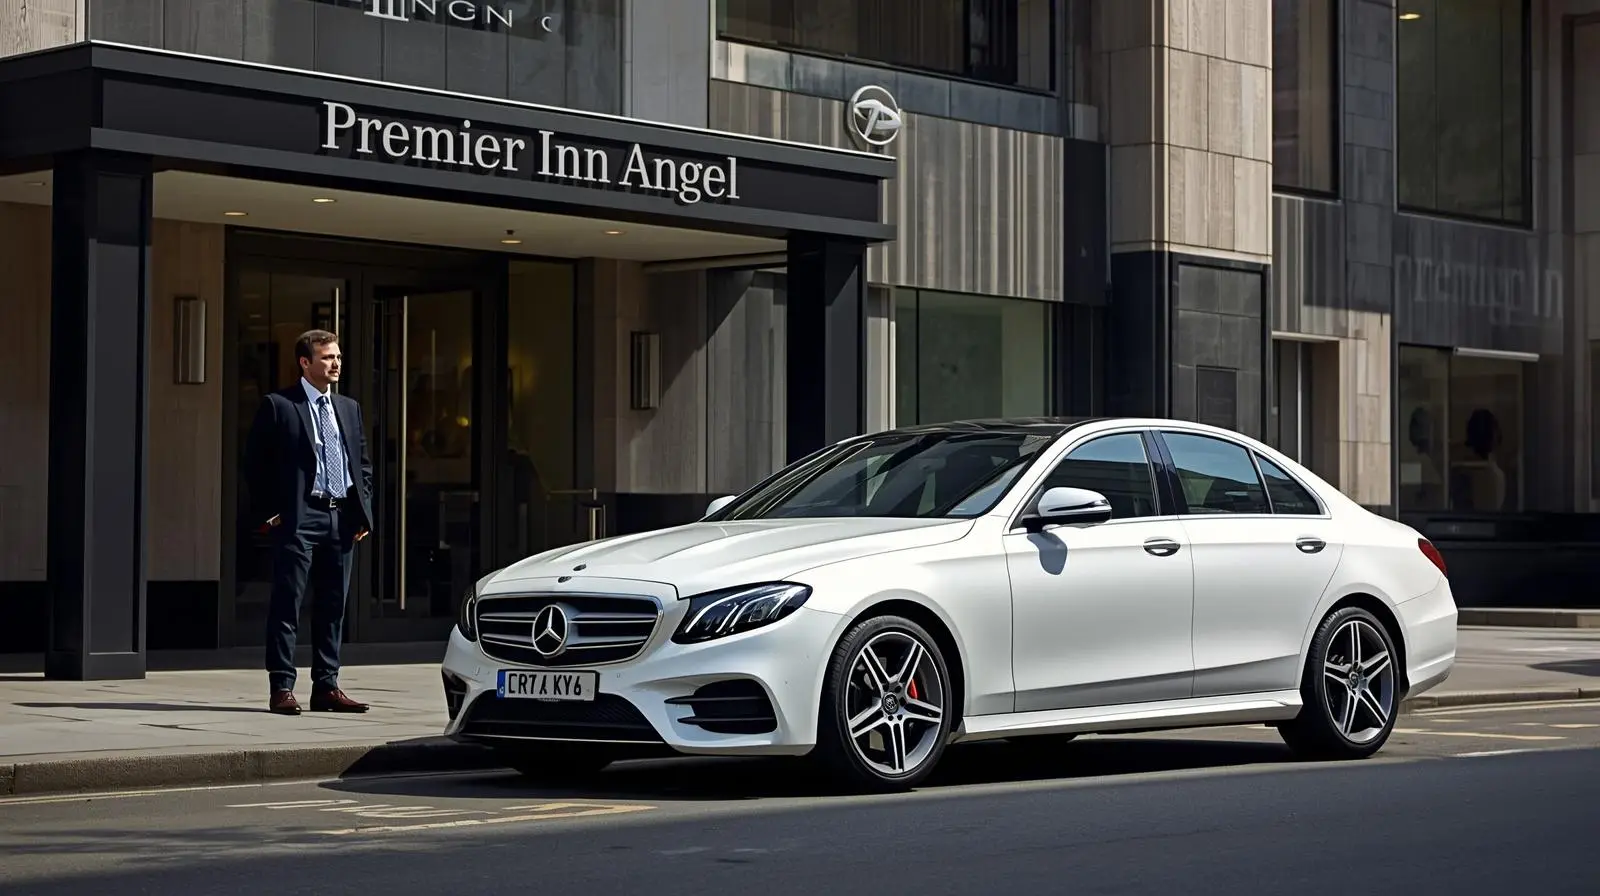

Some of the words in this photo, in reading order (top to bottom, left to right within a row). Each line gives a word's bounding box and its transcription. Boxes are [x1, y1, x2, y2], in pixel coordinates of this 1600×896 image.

[322, 101, 525, 171] Premier
[538, 130, 611, 183] Inn
[618, 143, 740, 204] Angel
